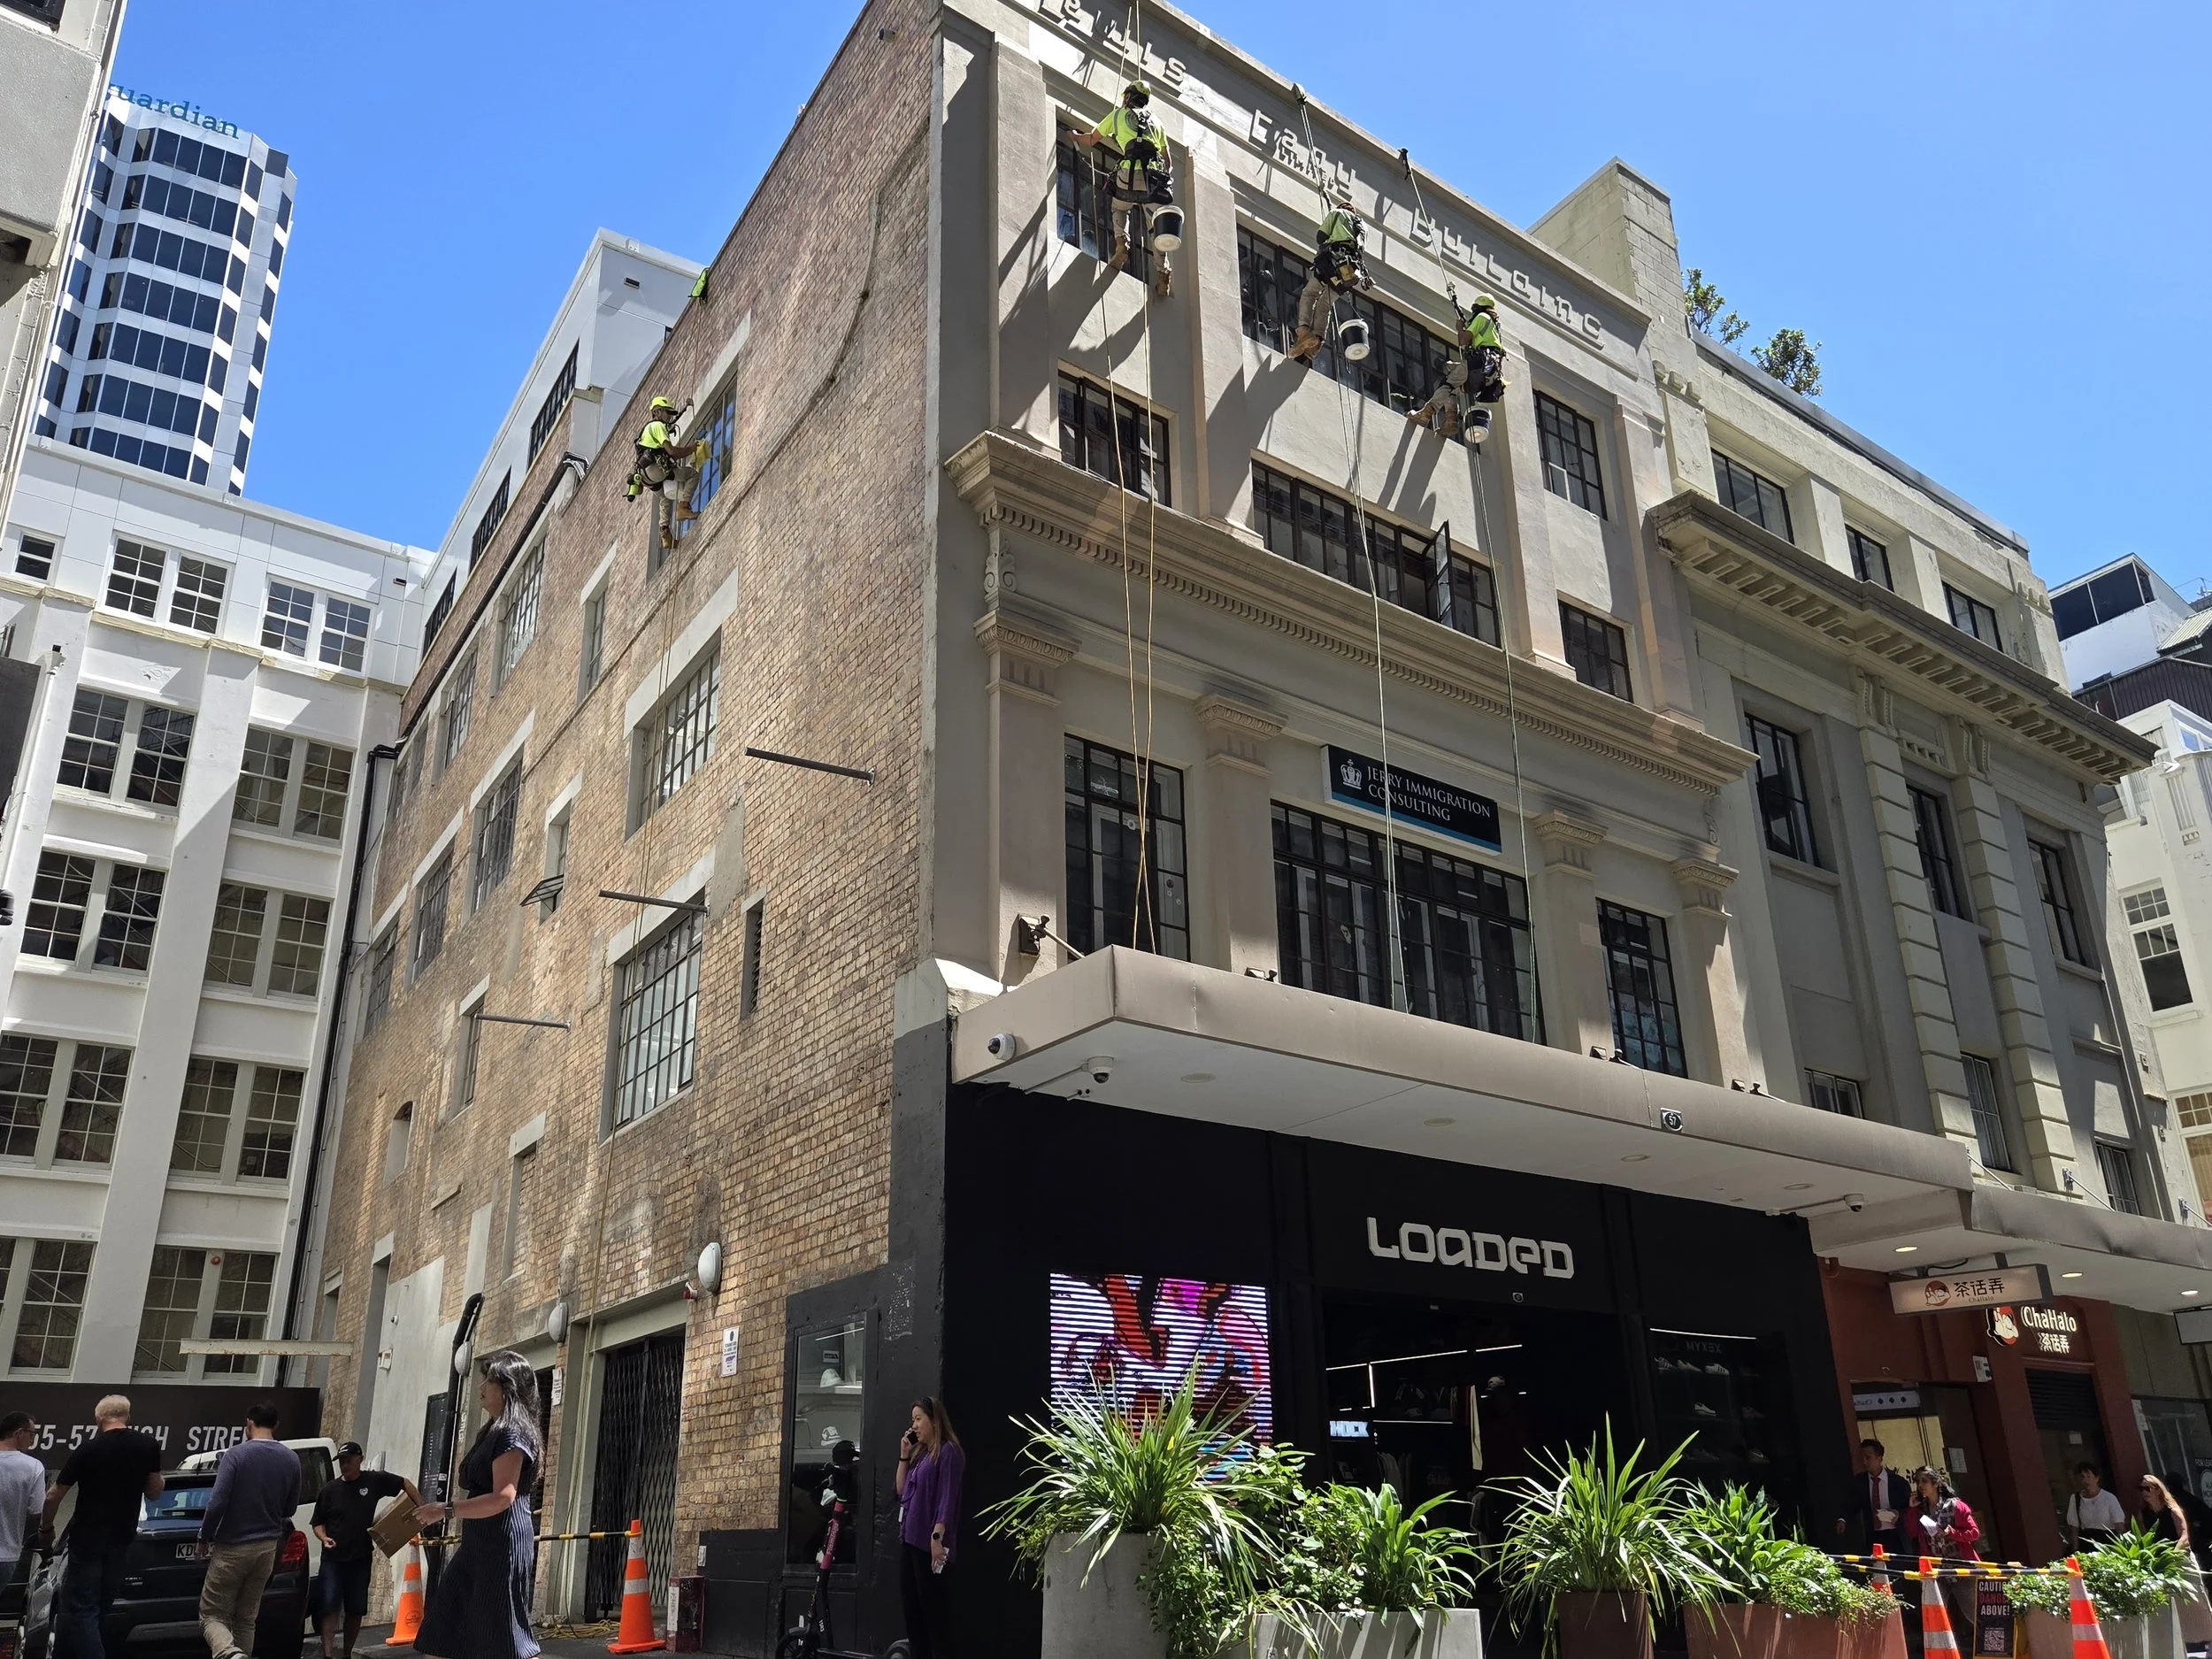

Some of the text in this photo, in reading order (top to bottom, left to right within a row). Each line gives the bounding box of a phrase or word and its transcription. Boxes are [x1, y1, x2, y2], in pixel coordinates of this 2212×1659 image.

[1368, 765, 1491, 818] JERRY IMMIGRATION
[1369, 785, 1450, 821] CONSULTING
[1955, 1278, 2005, 1298] 茶话弄
[2022, 1306, 2077, 1332] ChaHalo
[2040, 1333, 2070, 1354] 茶话弄
[187, 1426, 249, 1450] STRE
[1978, 1581, 2006, 1592] CAUTI
[1979, 1594, 2007, 1603] DANGE
[1980, 1605, 2009, 1616] ABOVE!
